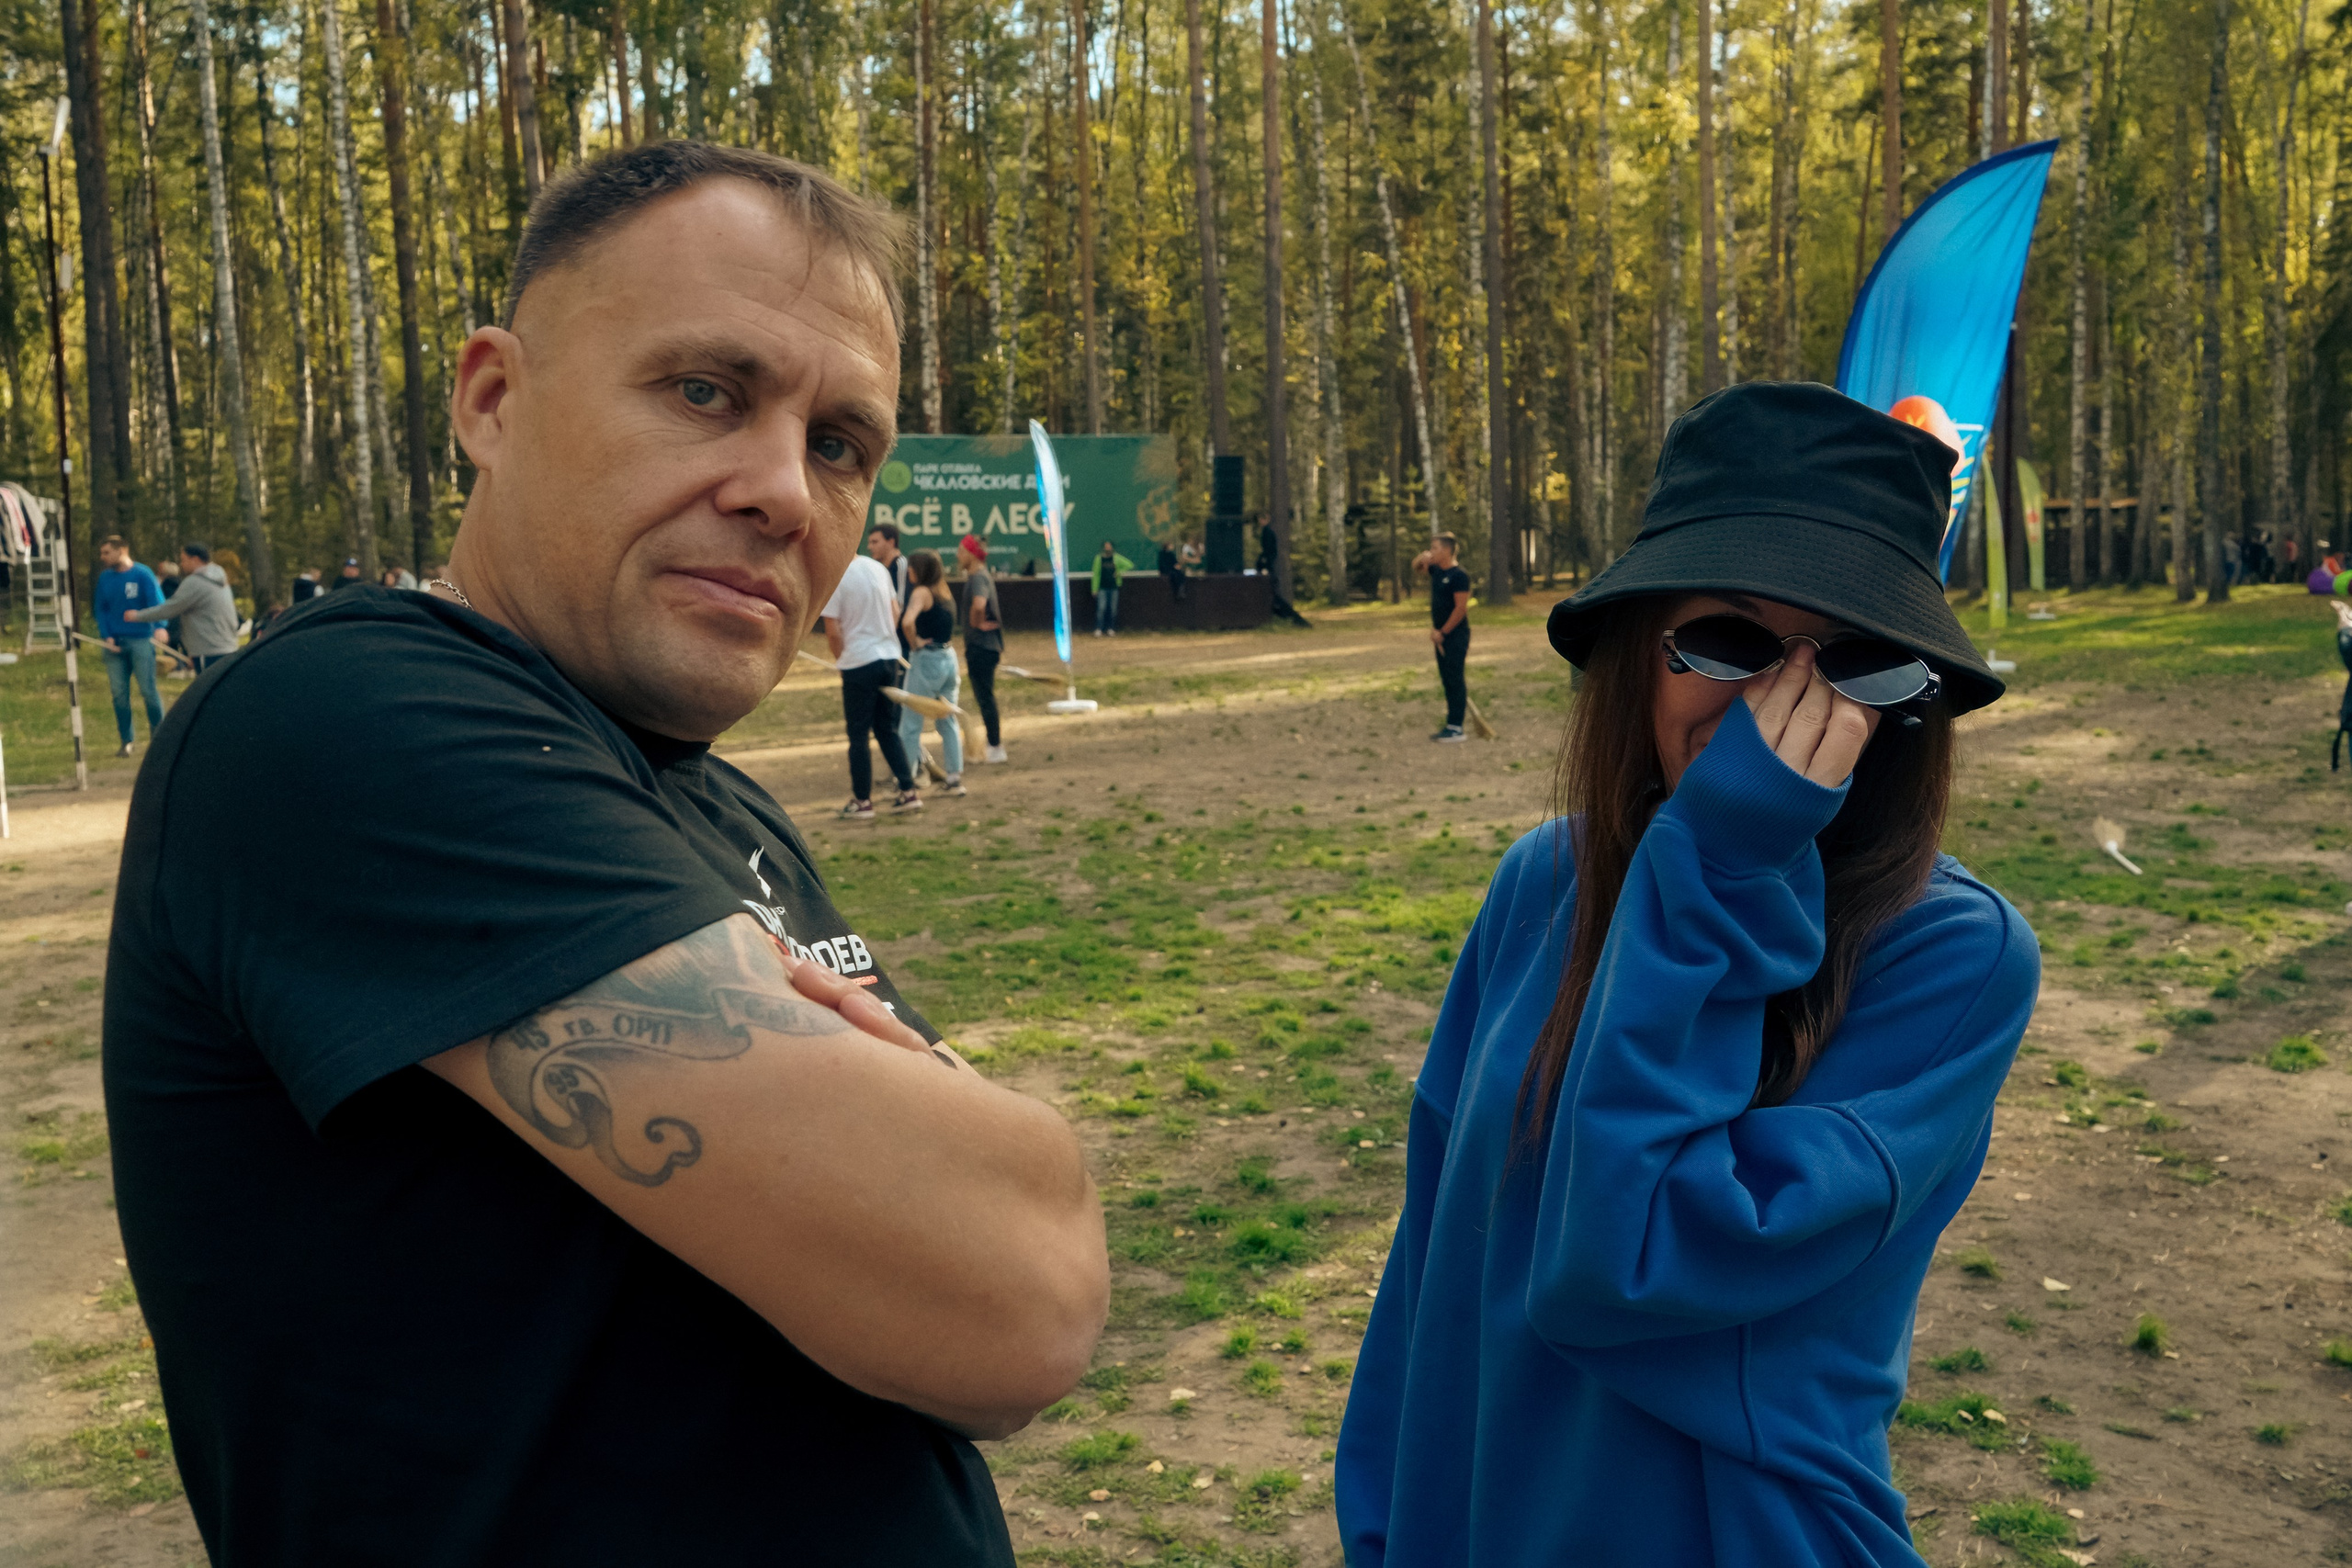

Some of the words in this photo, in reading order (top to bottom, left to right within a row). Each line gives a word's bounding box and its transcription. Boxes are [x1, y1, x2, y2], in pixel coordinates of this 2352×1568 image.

[913, 474, 1021, 491] ЧКАЛОВСКИЕ
[874, 496, 943, 536] ВСЁ
[951, 503, 974, 536] В
